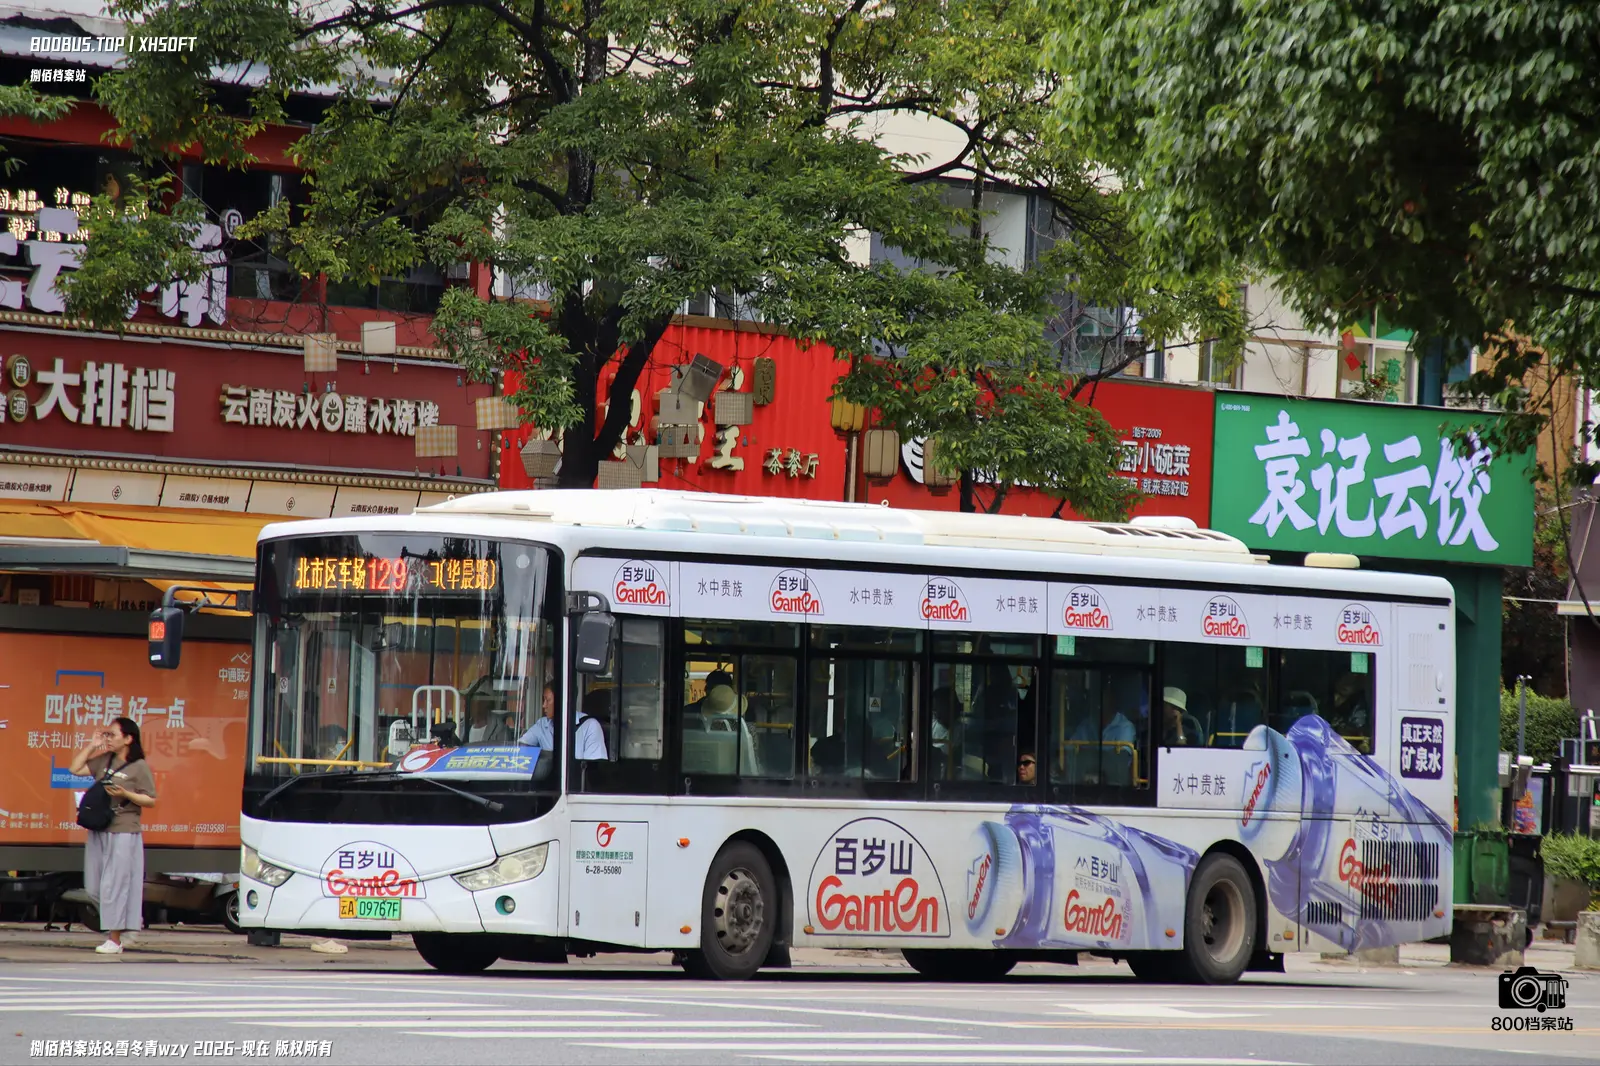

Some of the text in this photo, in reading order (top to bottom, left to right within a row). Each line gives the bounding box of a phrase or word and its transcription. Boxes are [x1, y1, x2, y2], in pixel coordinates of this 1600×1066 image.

[35, 357, 176, 433] 大排档
[223, 386, 320, 431] 云南炭火
[764, 448, 819, 479] 茶餐厅
[1248, 410, 1500, 552] 袁记云饺
[295, 557, 366, 590] 北市区车场
[368, 557, 408, 591] 129
[623, 567, 655, 582] 百岁山
[778, 576, 809, 592] 百岁山
[615, 581, 667, 606] Ganten
[697, 578, 743, 598] 水中贵族
[849, 586, 894, 606] 水中贵族
[927, 584, 957, 600] 百岁山
[771, 590, 820, 614] Ganten
[921, 597, 967, 621] Ganten
[996, 596, 1039, 614] 水中贵族
[1071, 592, 1100, 608] 百岁山
[1209, 602, 1237, 617] 百岁山
[1064, 606, 1109, 630] Ganten
[1136, 604, 1179, 623] 水中贵族
[1272, 613, 1313, 631] 水中贵族
[1343, 609, 1371, 625] 百岁山
[1203, 615, 1246, 639] Ganten
[1337, 623, 1380, 645] Ganten
[45, 694, 185, 728] 四代洋房 好一点
[27, 732, 72, 749] 联大书山
[1402, 723, 1443, 745] 真正天然
[1401, 747, 1442, 773] 矿泉水
[1173, 773, 1226, 796] 水中贵族
[338, 850, 395, 869] 百岁山
[835, 838, 913, 876] 百岁山
[585, 865, 622, 875] 6-28-55080
[1091, 856, 1119, 884] 百岁山
[327, 869, 417, 897] Ganten
[340, 899, 399, 917] 云A 09767F
[816, 875, 939, 934] Ganten
[1064, 889, 1122, 940] Ganten
